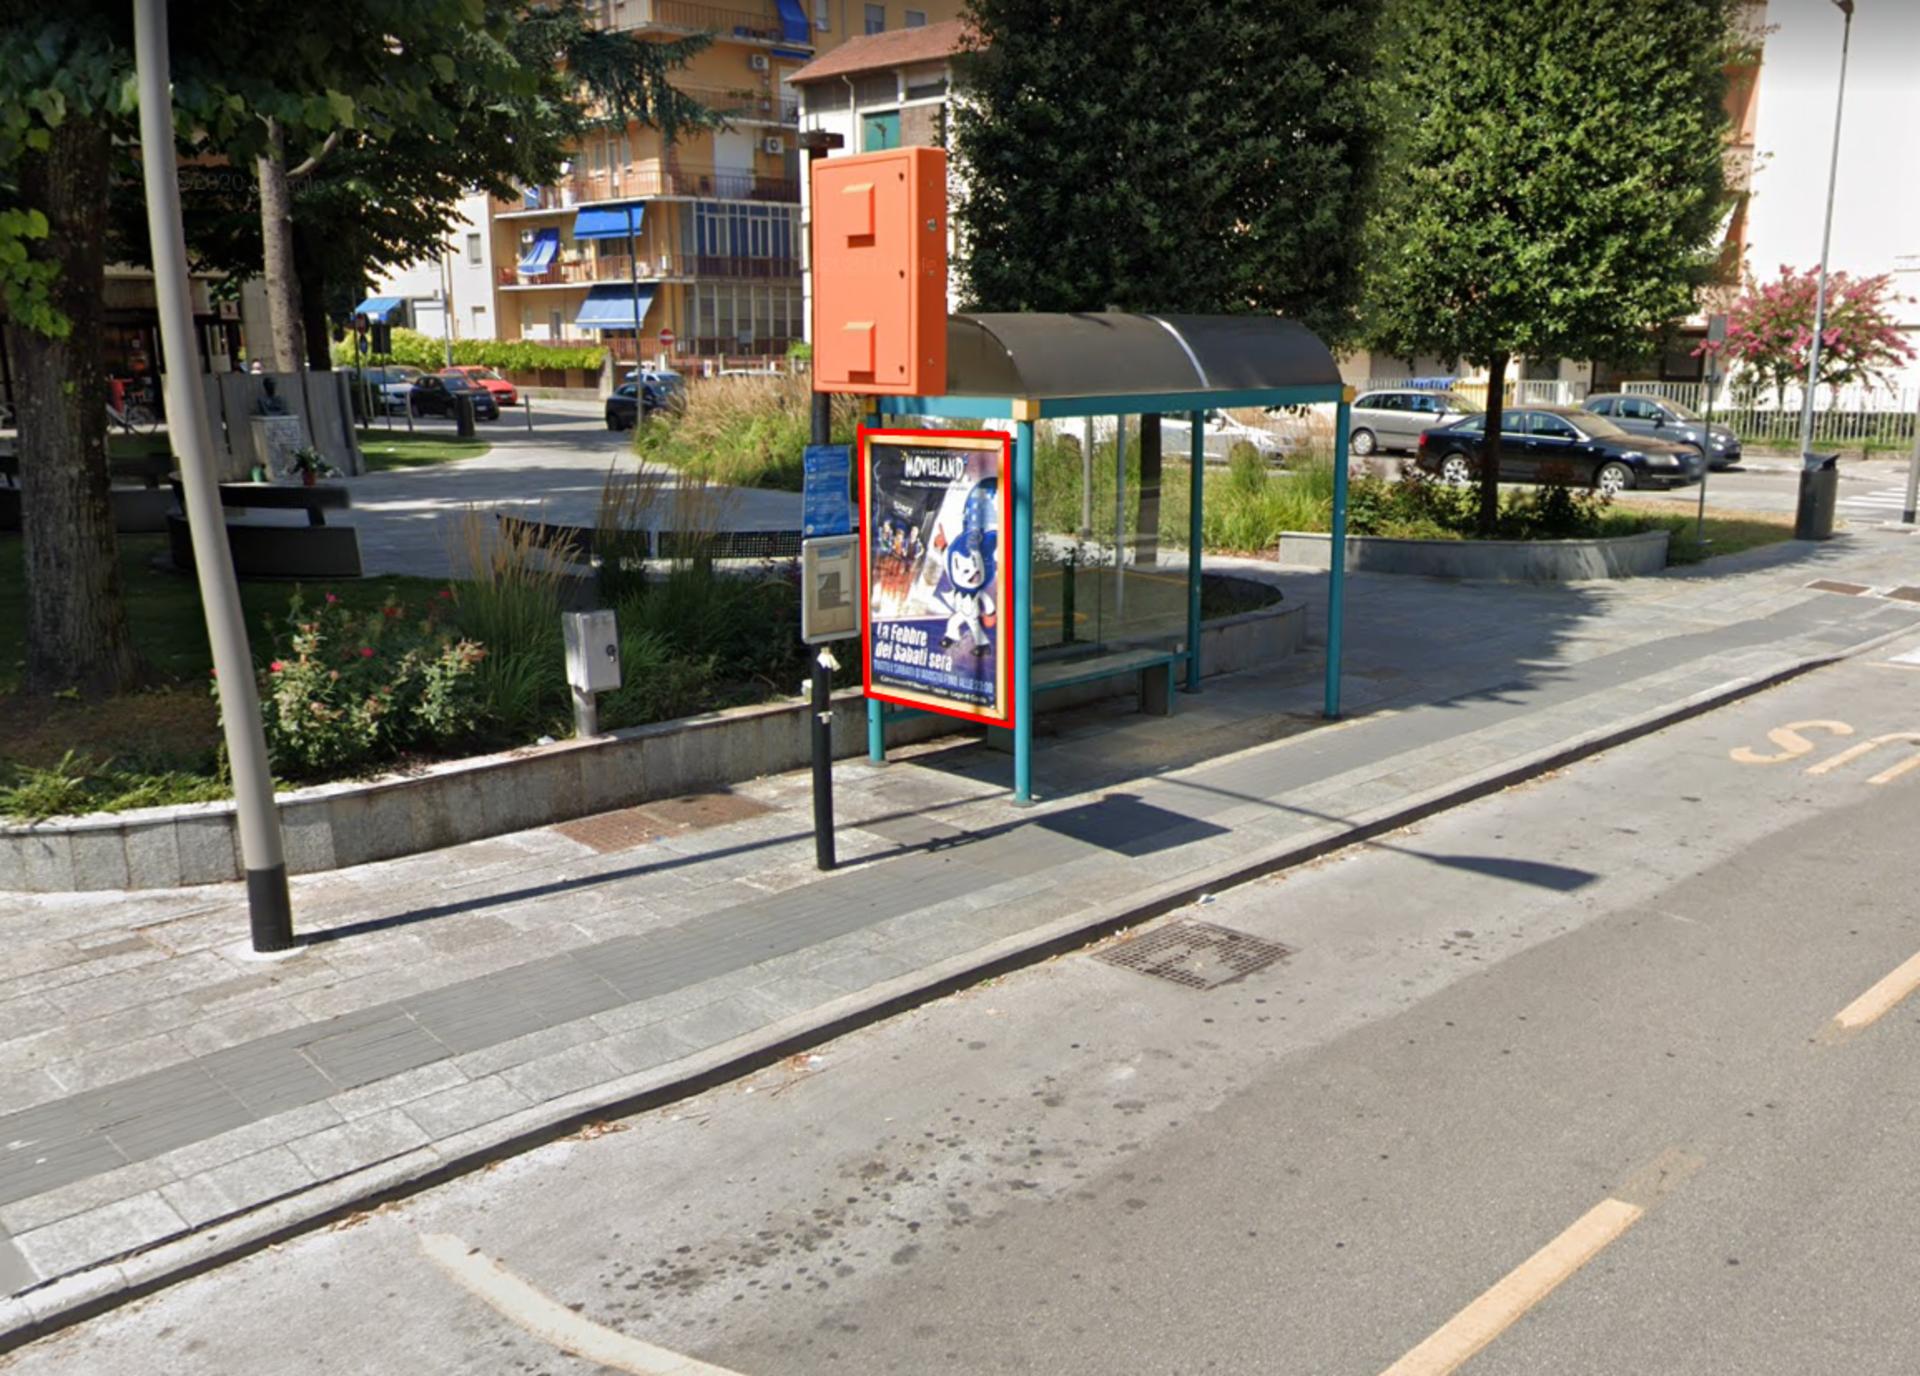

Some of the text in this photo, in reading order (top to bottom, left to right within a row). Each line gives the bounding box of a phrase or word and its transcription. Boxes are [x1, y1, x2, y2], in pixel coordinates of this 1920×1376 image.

[905, 456, 963, 481] MOVIELAND
[877, 623, 928, 646] La Febbre
[876, 640, 893, 658] dei
[929, 652, 953, 672] sera
